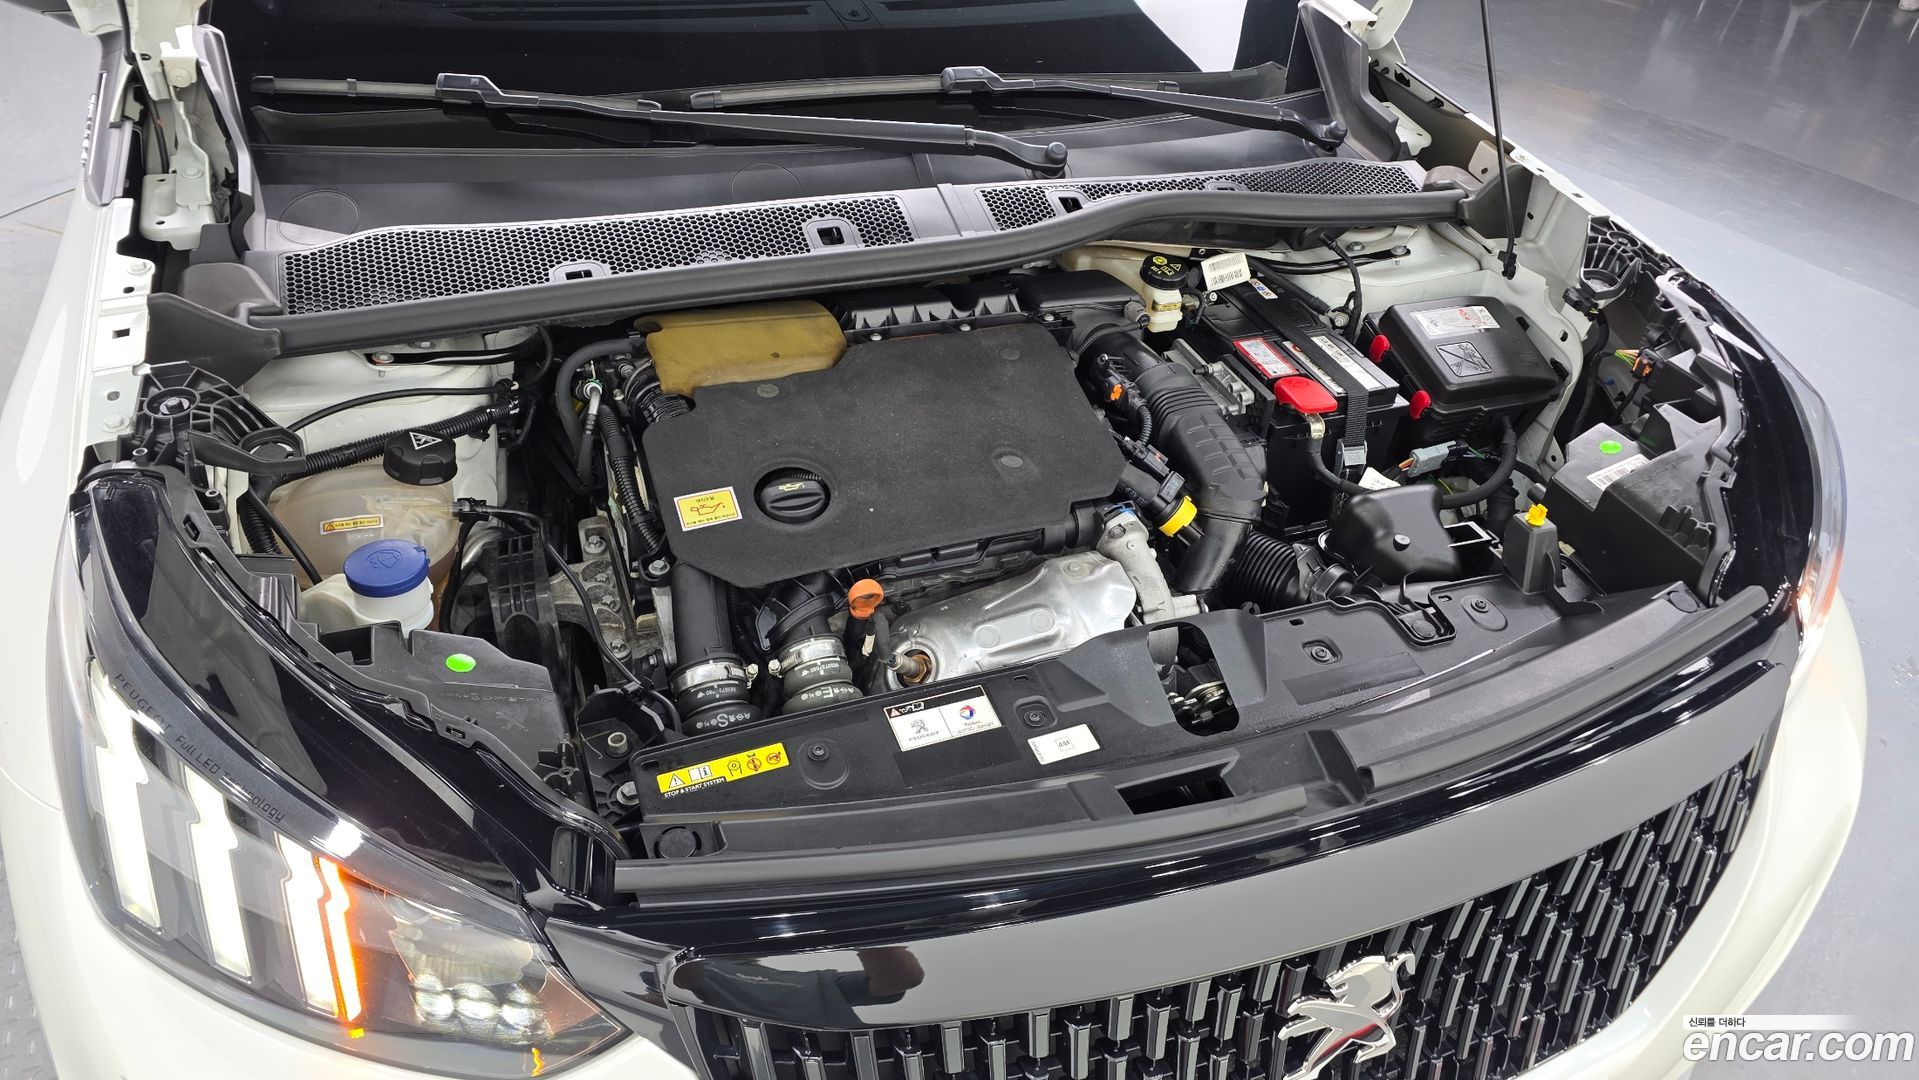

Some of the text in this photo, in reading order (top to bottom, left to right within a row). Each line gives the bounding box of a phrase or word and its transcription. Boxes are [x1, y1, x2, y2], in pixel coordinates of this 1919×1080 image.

[195, 752, 221, 775] LED
[664, 789, 680, 798] STOP
[684, 782, 703, 792] START
[703, 776, 725, 787] SYSTEM
